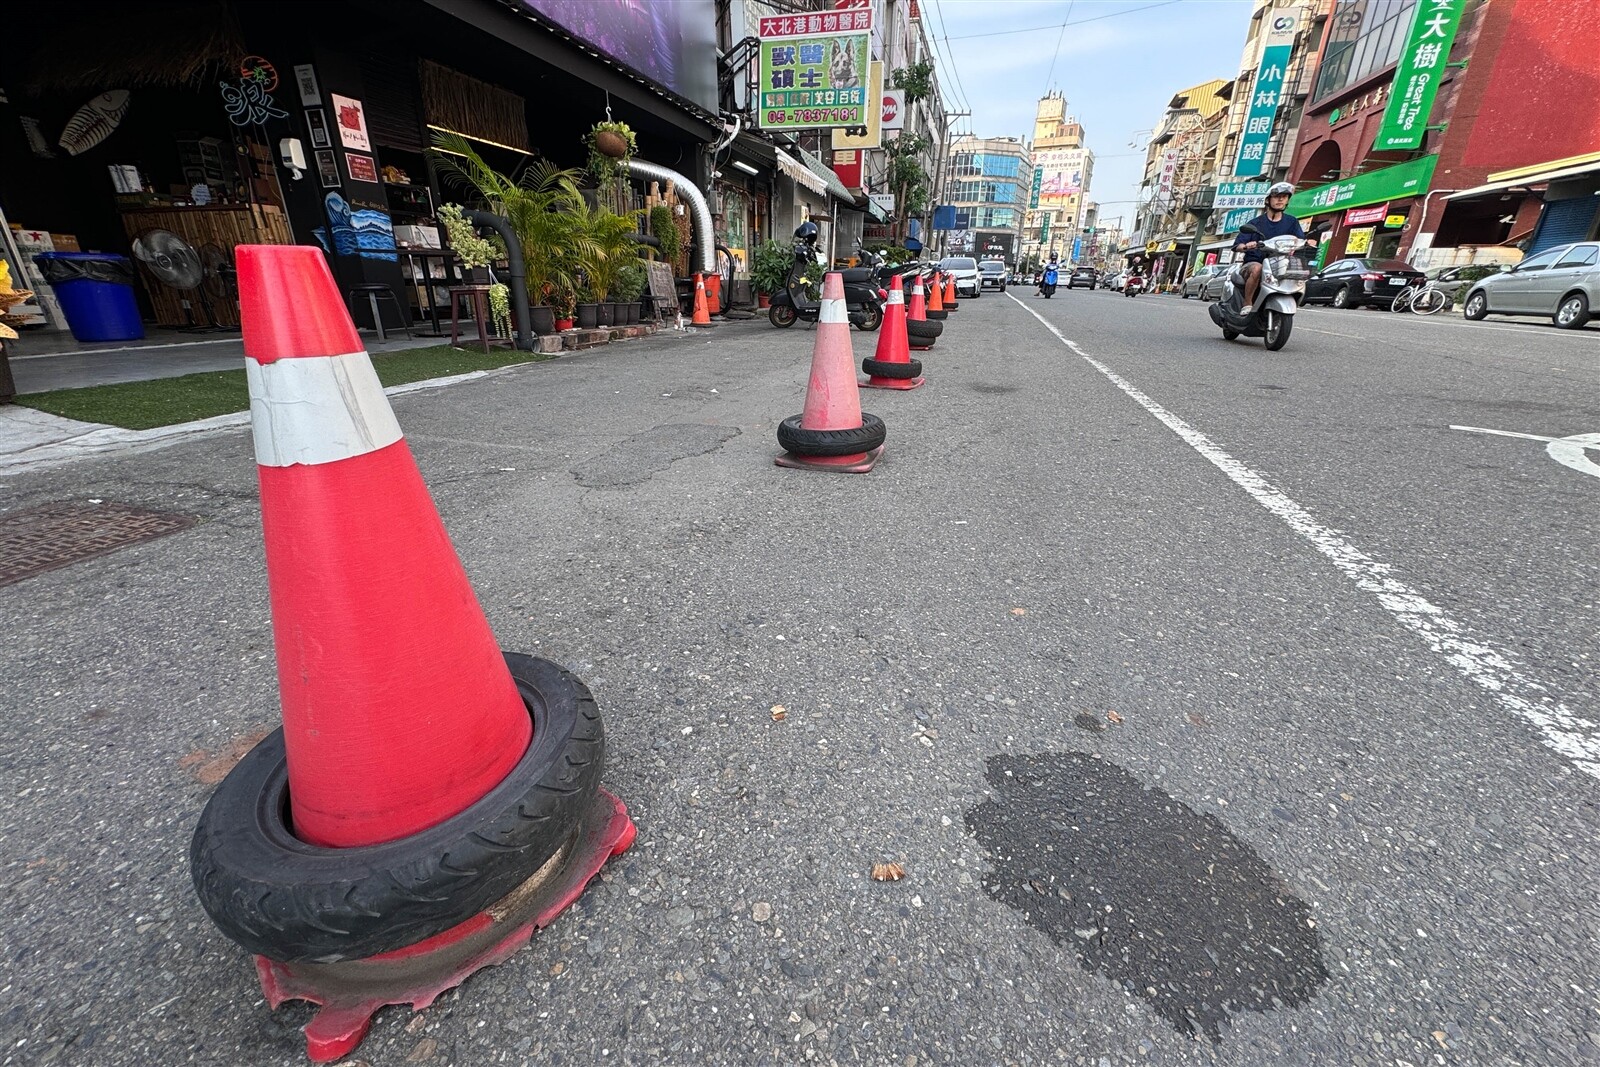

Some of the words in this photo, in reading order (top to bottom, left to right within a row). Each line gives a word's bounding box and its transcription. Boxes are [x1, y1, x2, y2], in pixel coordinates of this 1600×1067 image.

[763, 12, 869, 36] 大北港動物醫院
[1412, 12, 1451, 69] 大樹
[771, 44, 824, 66] 獸醫
[771, 68, 823, 89] 碩士
[1410, 73, 1430, 106] Great
[839, 90, 861, 105] 百貨
[767, 107, 858, 123] 05-7837181
[1241, 64, 1282, 160] 小林眼鏡
[1403, 105, 1421, 131] Tree
[1219, 183, 1269, 195] 小林眼鏡
[1217, 197, 1265, 207] 北港驗光所
